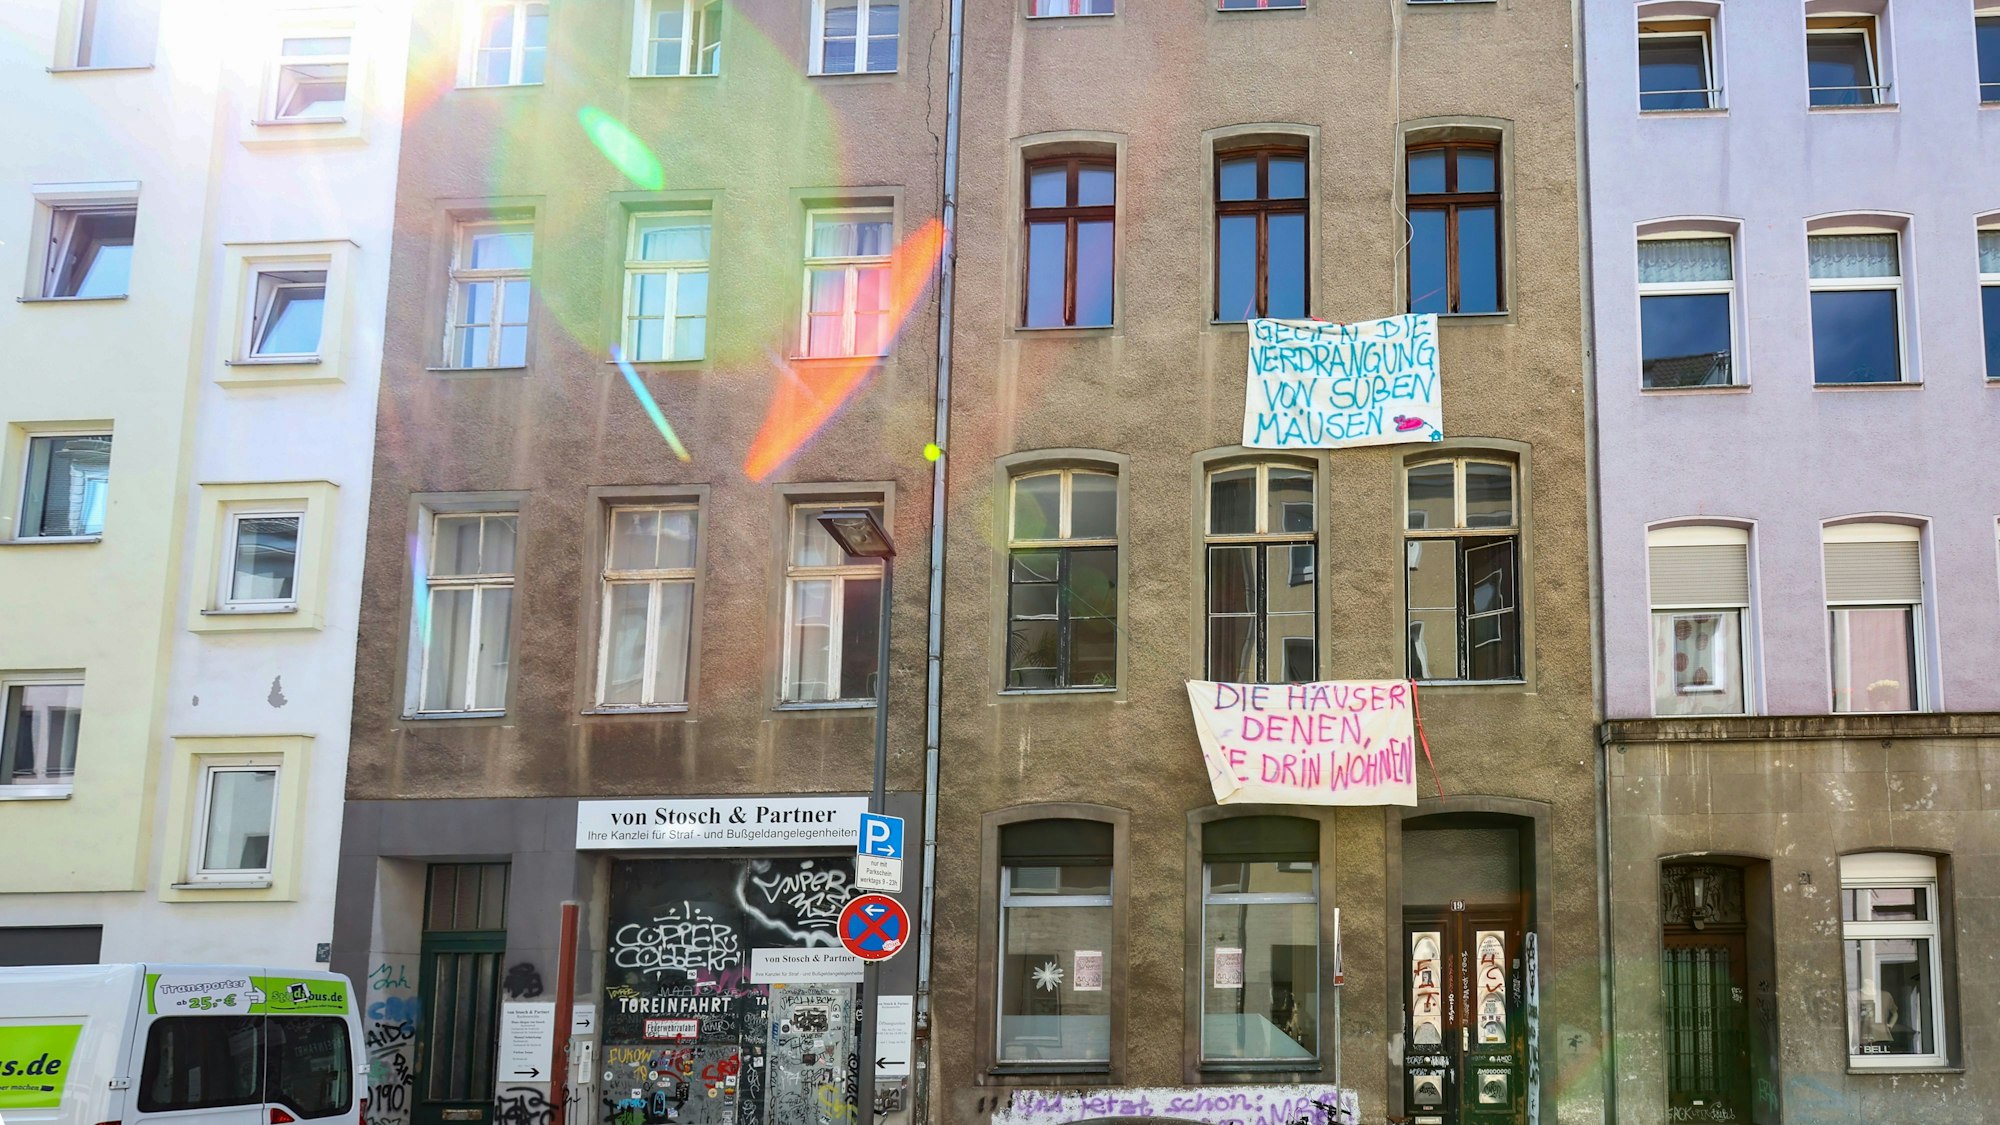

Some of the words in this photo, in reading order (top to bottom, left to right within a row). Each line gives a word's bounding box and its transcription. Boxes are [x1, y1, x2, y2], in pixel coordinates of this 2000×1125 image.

[1376, 314, 1431, 339] DIE
[1264, 378, 1317, 411] VON
[1253, 407, 1383, 445] MÄUSEN
[1214, 683, 1270, 711] DIE
[1288, 683, 1406, 712] HÄUSER
[1241, 714, 1372, 749] DENEN,
[1331, 735, 1412, 791] WOHNEN
[611, 812, 647, 826] von
[654, 807, 721, 825] Stosch
[728, 806, 747, 824] &
[756, 806, 837, 823] Partner
[588, 830, 608, 841] Ihre
[610, 830, 649, 841] Kanzlei
[652, 829, 666, 840] für
[669, 829, 694, 840] Straf
[703, 829, 724, 840] und
[727, 827, 858, 842] Bußgeldangelegenheiten
[866, 819, 891, 853] P
[866, 868, 892, 877] Parkschein
[860, 877, 881, 886] werktags
[1452, 901, 1464, 911] 19
[782, 955, 810, 963] Stosch
[812, 954, 820, 962] &
[823, 954, 857, 962] Partner
[160, 979, 246, 994] Transporter
[619, 997, 731, 1013] TOREINFAHRT
[647, 1023, 696, 1032] Feuerwehrzufahrt
[1864, 1045, 1890, 1054] BELL
